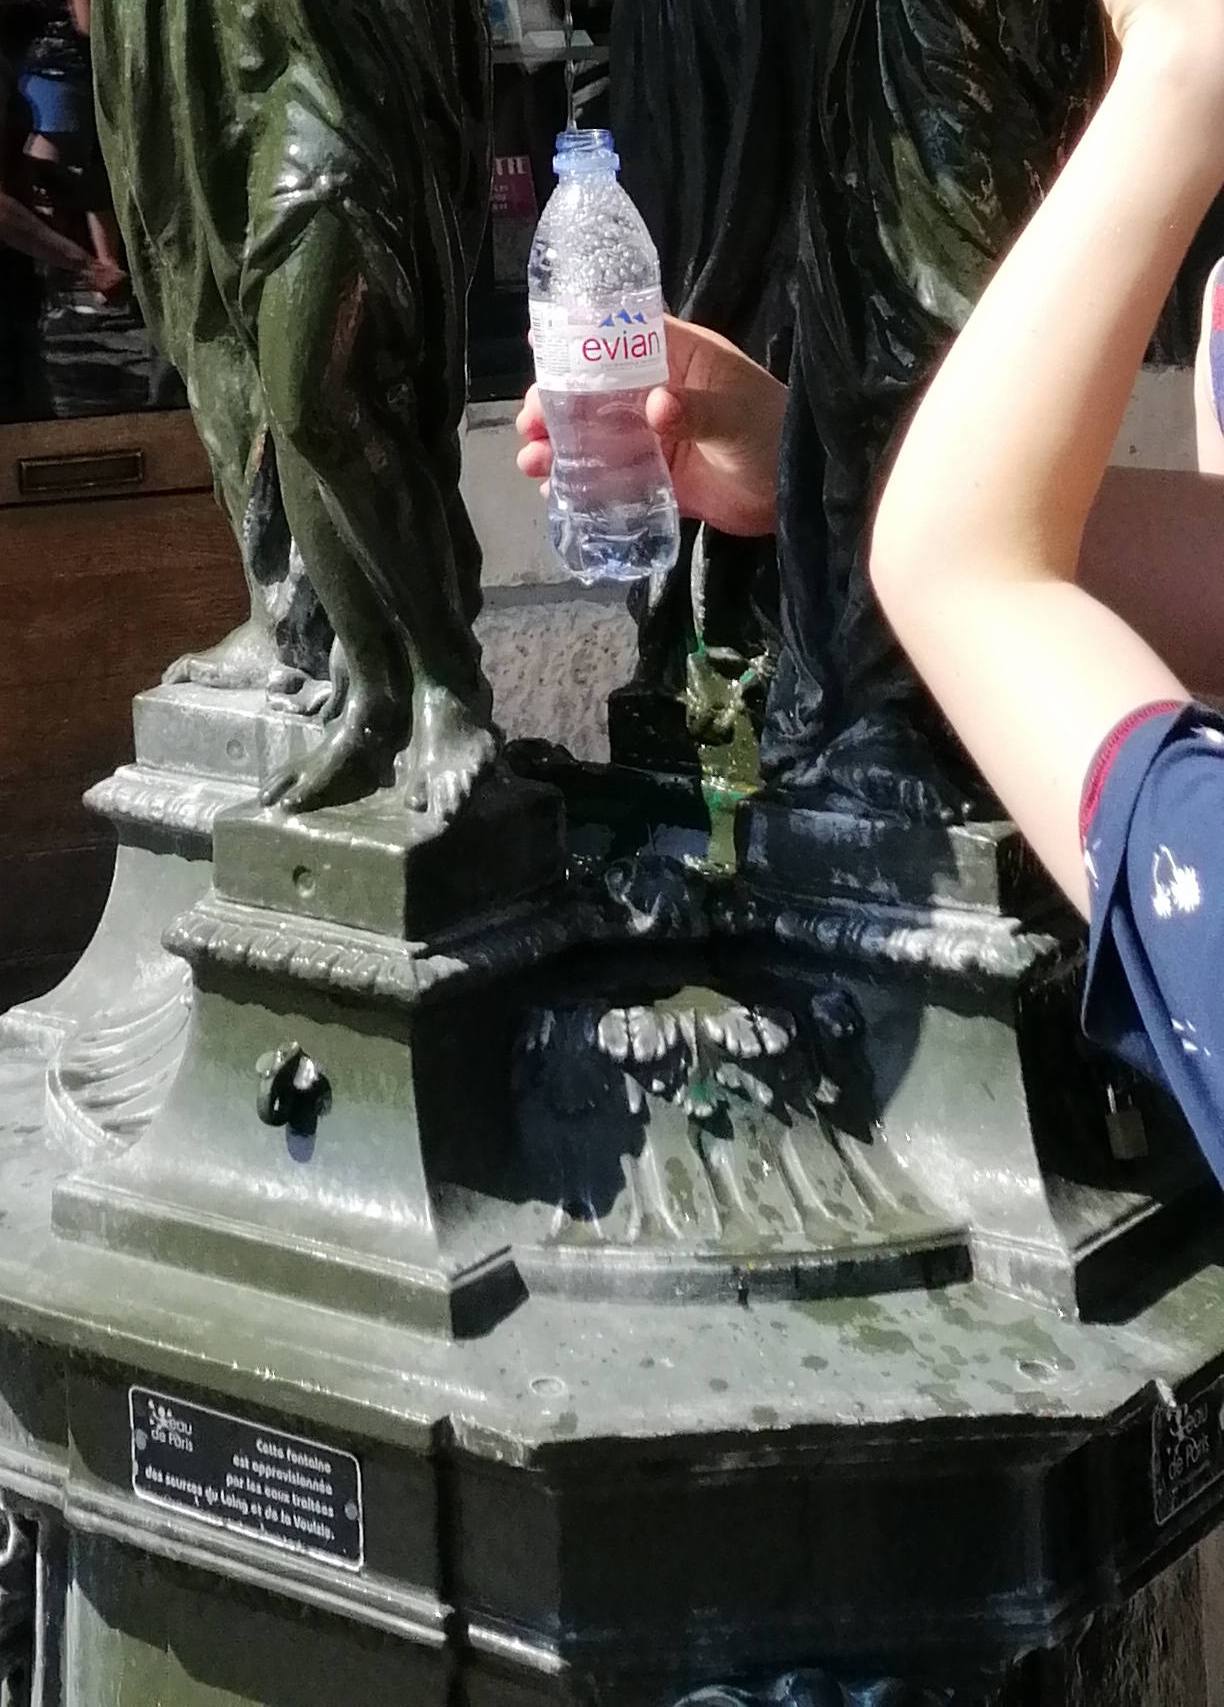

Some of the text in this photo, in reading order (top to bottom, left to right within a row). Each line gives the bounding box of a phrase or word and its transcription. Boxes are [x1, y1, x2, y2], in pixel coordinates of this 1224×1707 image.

[581, 329, 661, 363] evian
[151, 1428, 194, 1453] de Paris
[167, 1418, 193, 1436] eau
[232, 1453, 250, 1471] est
[256, 1437, 332, 1475] Cette fontaine
[145, 1464, 164, 1483] des
[165, 1472, 203, 1497] sources
[220, 1489, 249, 1515] Loing
[250, 1501, 262, 1518] et
[264, 1504, 279, 1522] de
[280, 1508, 292, 1526] la
[225, 1472, 244, 1489] par
[246, 1475, 262, 1495] les
[263, 1485, 291, 1504] eaux
